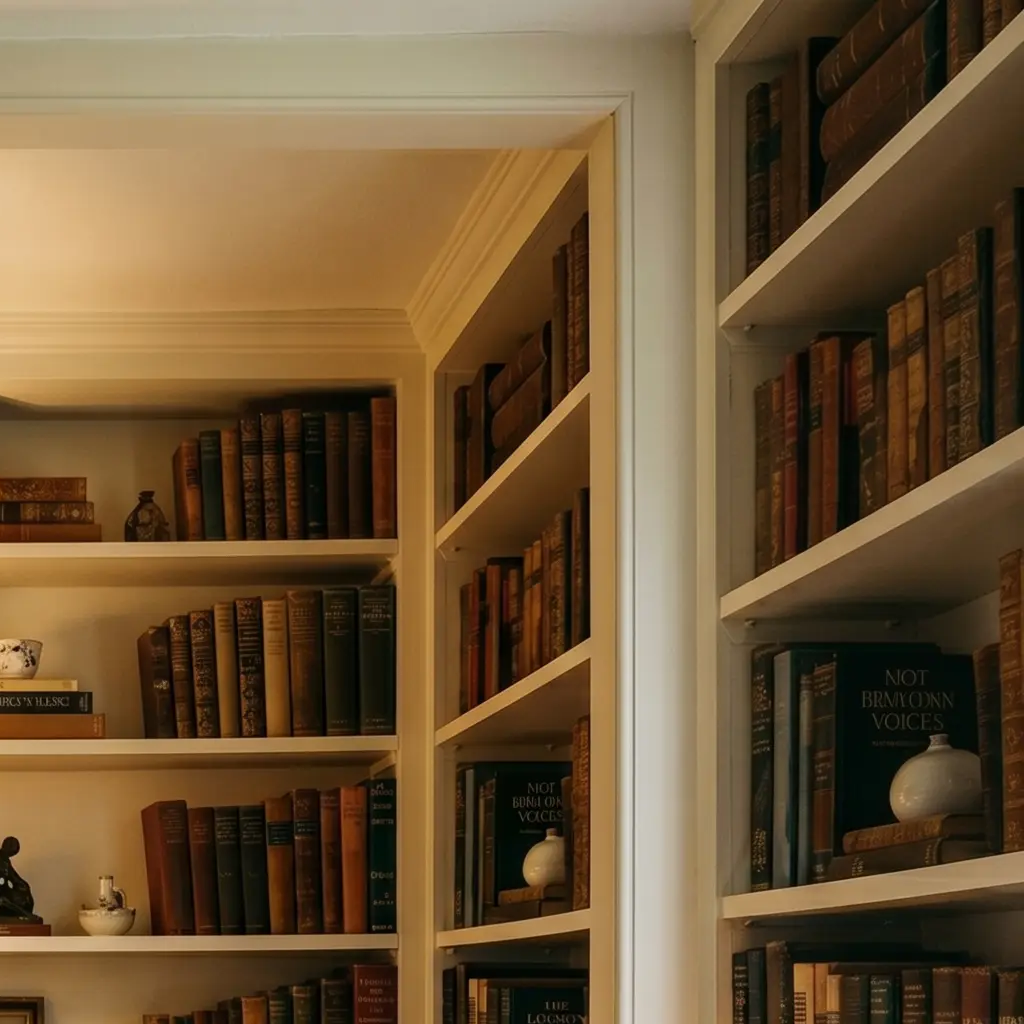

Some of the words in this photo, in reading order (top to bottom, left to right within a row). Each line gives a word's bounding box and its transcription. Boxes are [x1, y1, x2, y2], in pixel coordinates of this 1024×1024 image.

[884, 669, 930, 687] NOT
[871, 712, 944, 731] VOICES
[527, 782, 556, 795] NOT
